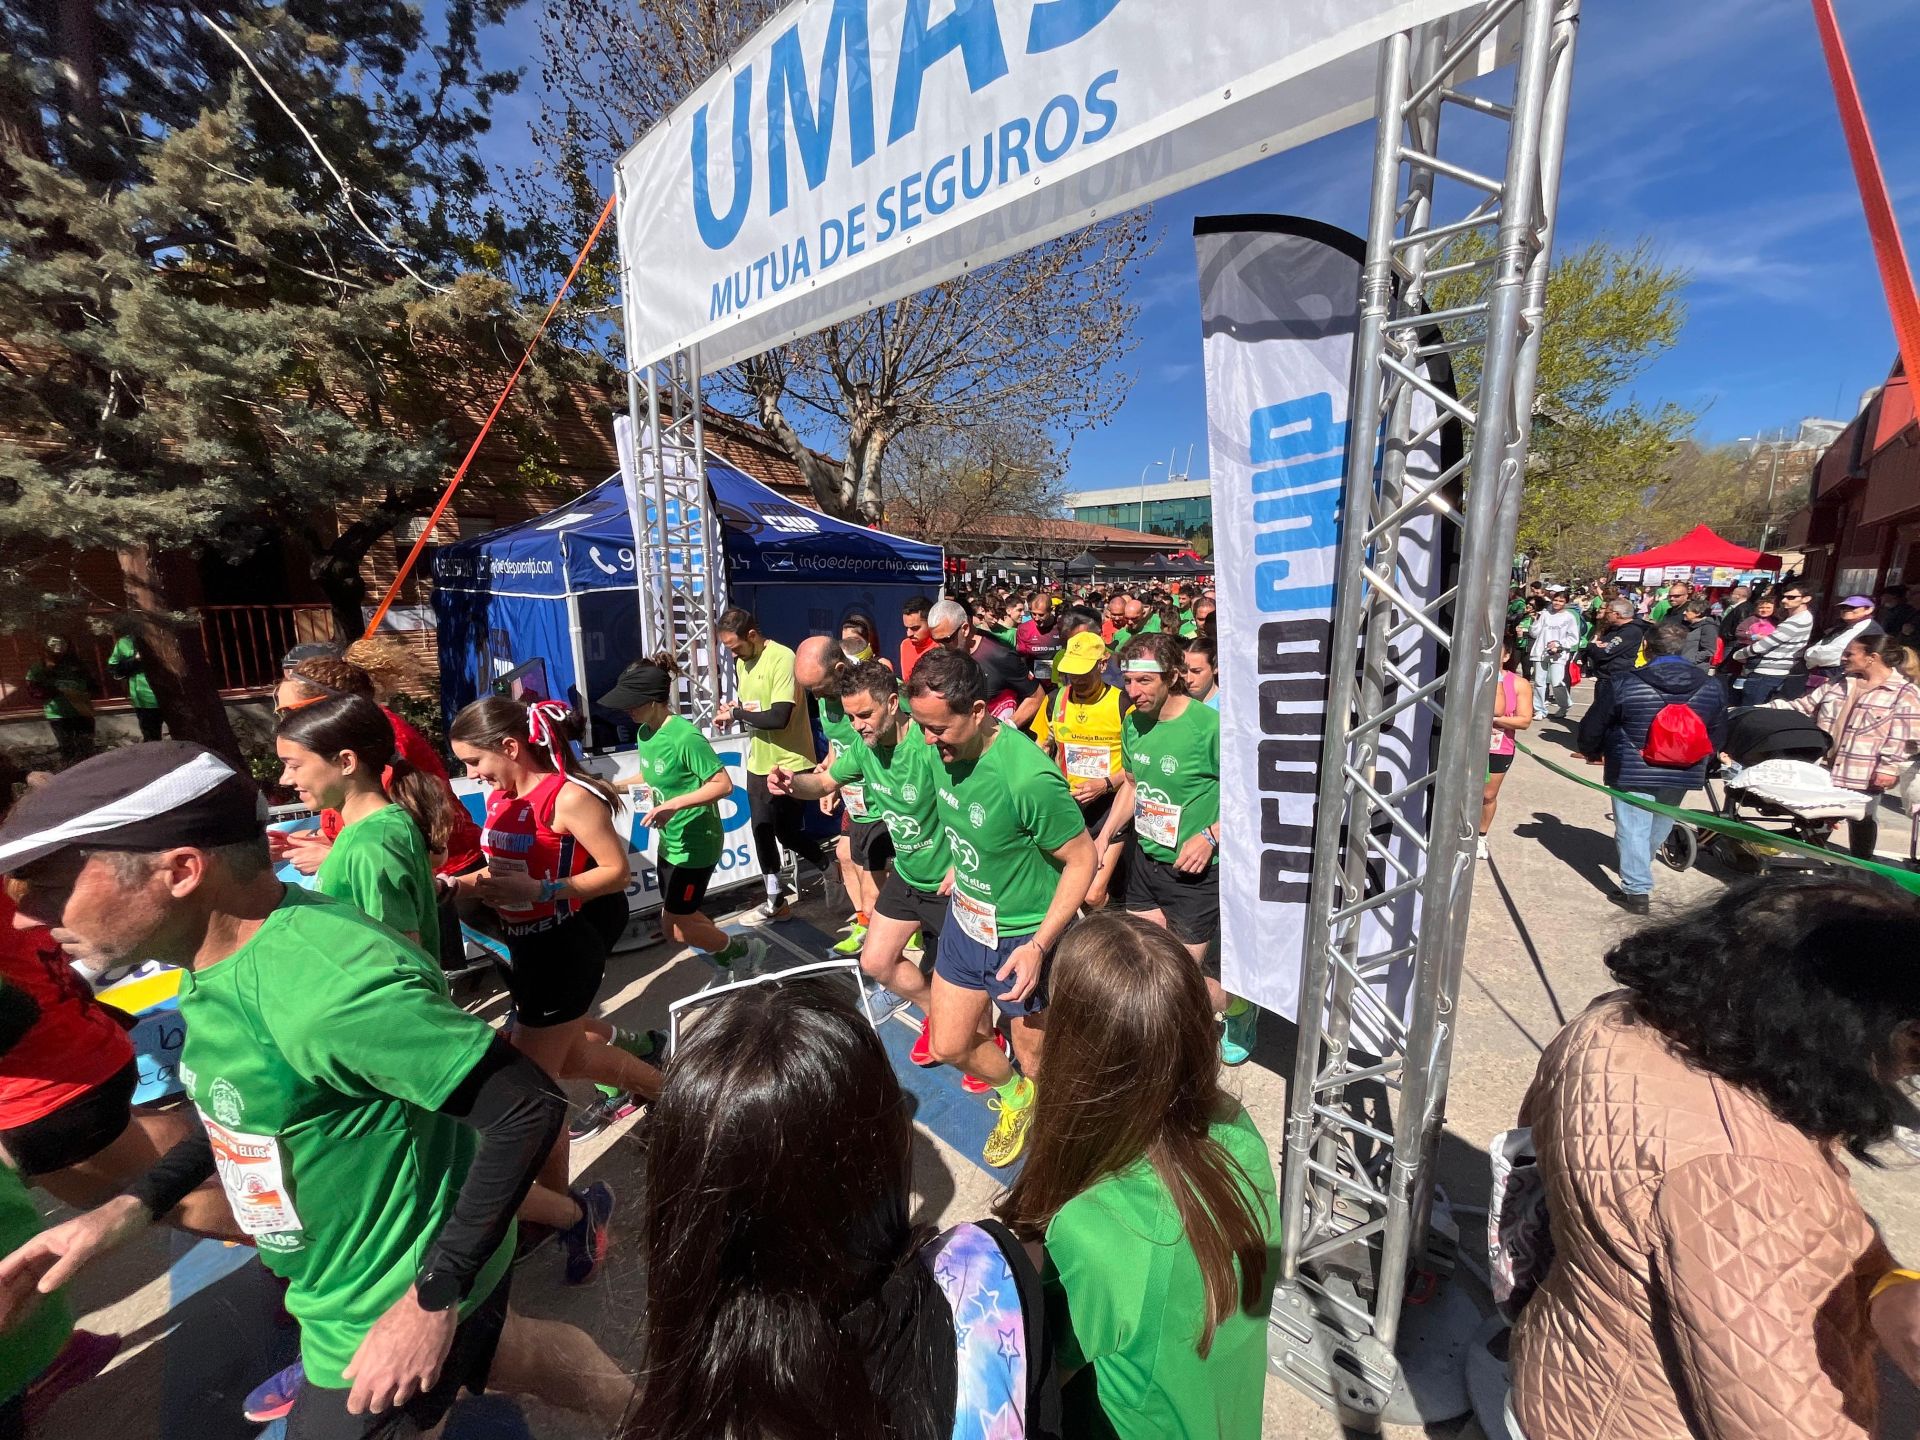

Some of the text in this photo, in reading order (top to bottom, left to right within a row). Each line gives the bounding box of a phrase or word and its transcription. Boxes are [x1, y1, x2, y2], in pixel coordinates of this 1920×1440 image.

[690, 0, 1121, 250] UMA
[709, 69, 1118, 321] MUTUA DE SEGUROS
[761, 514, 821, 534] CHIP
[799, 553, 930, 574] info@deporchip.com
[507, 917, 553, 937] NIKE
